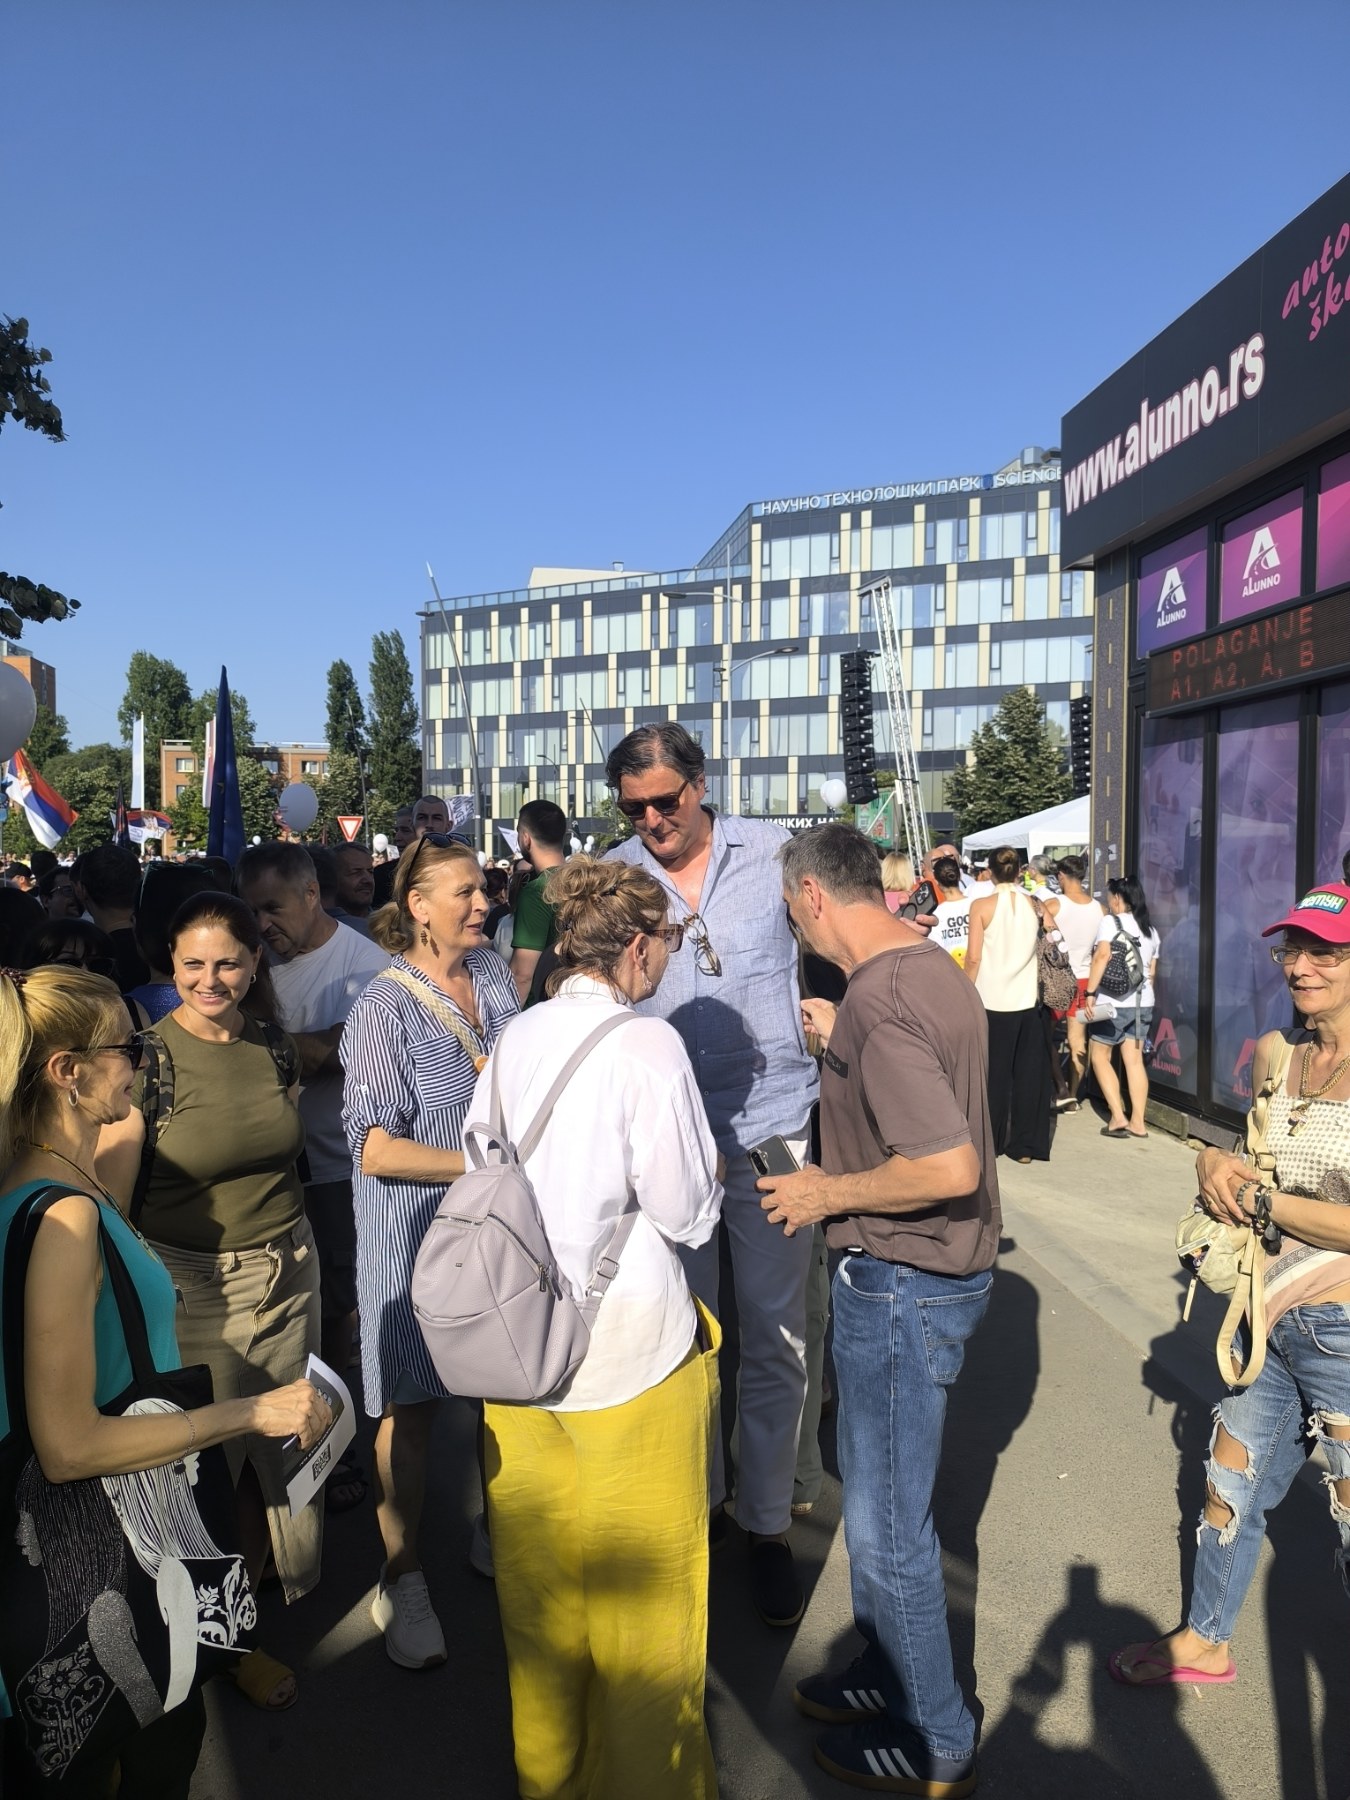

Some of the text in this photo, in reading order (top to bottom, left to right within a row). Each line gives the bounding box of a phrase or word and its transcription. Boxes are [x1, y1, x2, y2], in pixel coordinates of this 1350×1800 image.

[1281, 222, 1350, 319] auto
[1064, 333, 1265, 516] www.alunno.rs
[761, 476, 980, 516] НАУЧНО ТЕХНОЛОШКИ ПАРК
[1170, 640, 1314, 701] A1, A2, A, B
[1172, 606, 1313, 672] POLAGANJE
[1232, 1079, 1253, 1098] ALU
